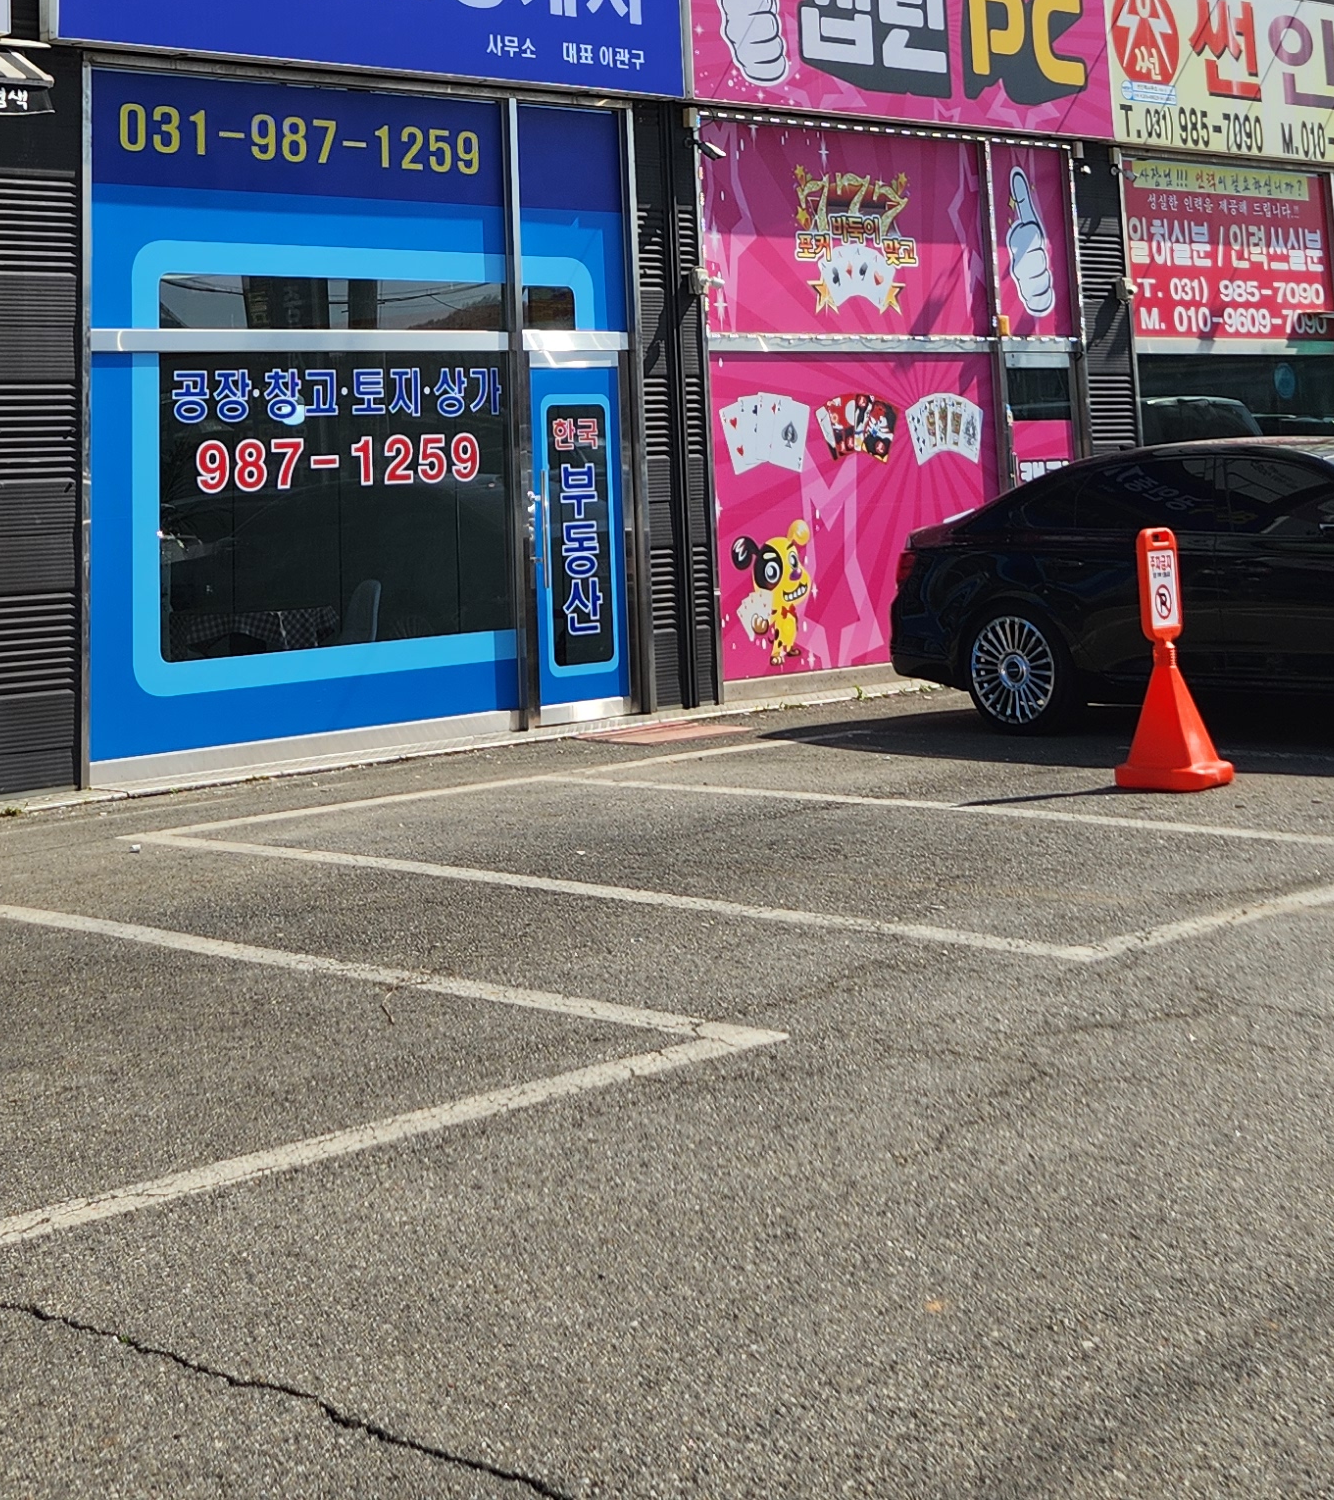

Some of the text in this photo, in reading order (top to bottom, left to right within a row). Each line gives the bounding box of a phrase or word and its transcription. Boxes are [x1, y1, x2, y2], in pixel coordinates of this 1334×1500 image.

[486, 34, 645, 70] 사무소 대표 이관구
[118, 102, 481, 176] 031-987-1259
[1178, 106, 1263, 153] 985-7090
[796, 172, 909, 236] 777
[1147, 193, 1179, 211] 성실한
[1183, 195, 1214, 213] 인력을
[1218, 198, 1248, 216] 제공해
[829, 214, 881, 244] 바둑이
[796, 232, 918, 267] 포커 맞고
[1170, 277, 1208, 304] 031)
[1219, 280, 1324, 305] 985-7090
[1174, 306, 1327, 335] 010-9609-7090
[551, 416, 600, 451] 한국
[194, 432, 481, 494] 987-1259
[559, 462, 603, 638] 부동산
